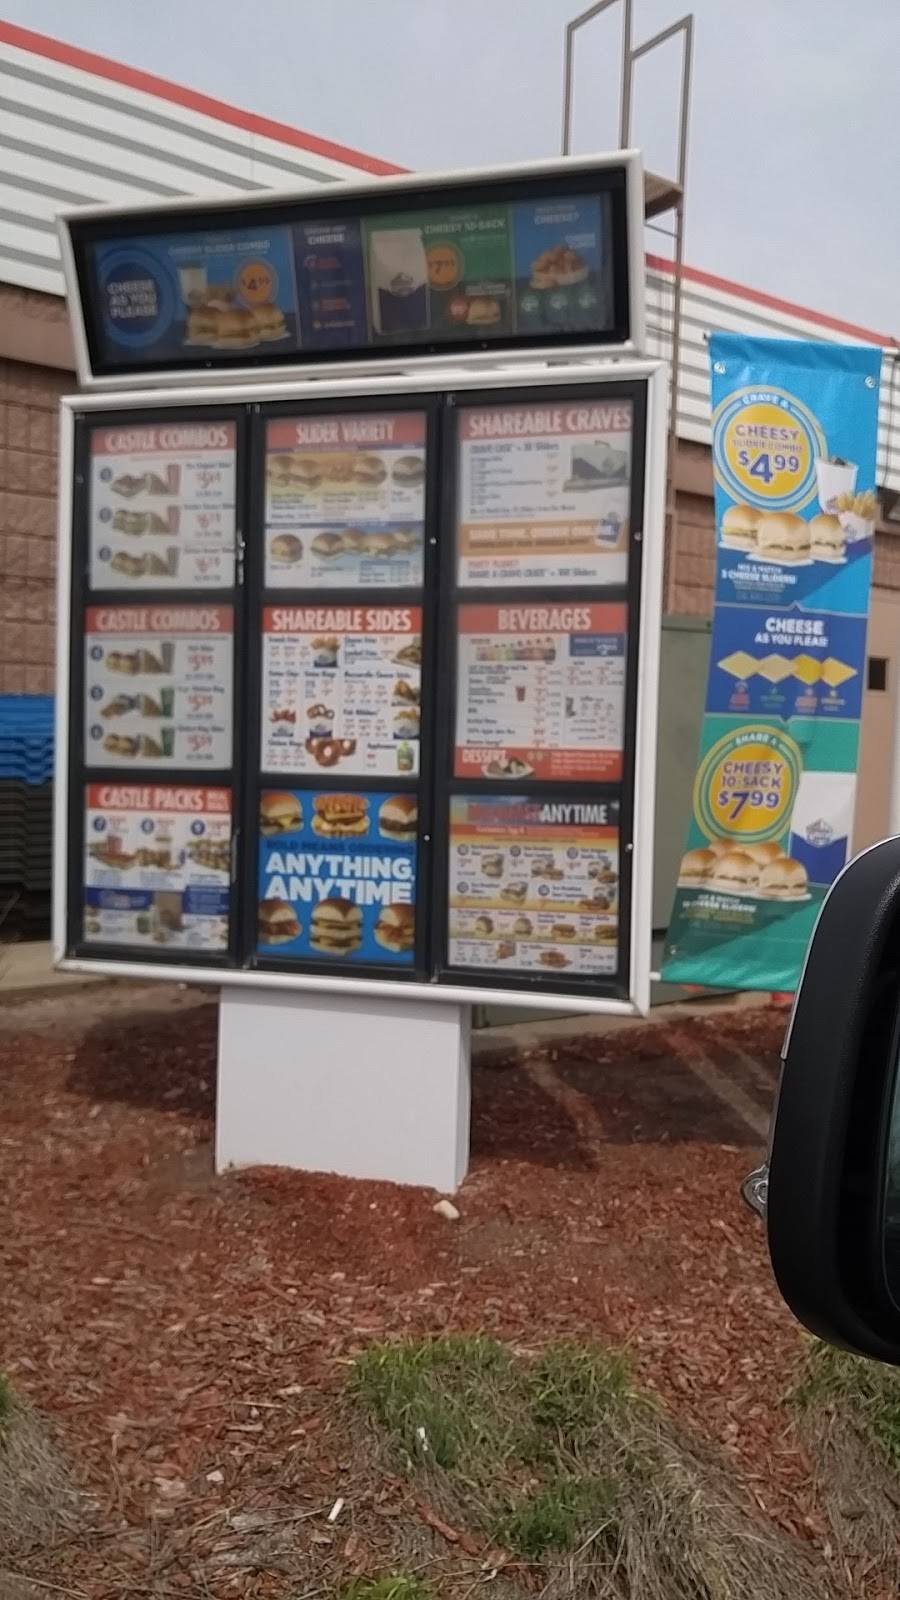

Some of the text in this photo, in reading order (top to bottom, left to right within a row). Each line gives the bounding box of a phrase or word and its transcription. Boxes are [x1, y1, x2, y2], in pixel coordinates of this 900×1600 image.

[469, 407, 631, 437] SHAREABLE CRAVES
[735, 424, 800, 442] CHEESY
[271, 609, 412, 632] SHAREABLE SIDES
[498, 608, 592, 631] BEVERAGES
[765, 617, 824, 635] CHEESE
[754, 633, 770, 645] AS
[771, 634, 794, 646] YOU
[723, 760, 784, 776] CHEESY
[721, 775, 782, 790] 10-SACK
[98, 786, 152, 809] CASTLE
[153, 787, 204, 810] PACKS
[539, 803, 608, 824] ANYTIME
[265, 851, 416, 881] ANYTHING,
[264, 874, 413, 906] ANYTIME
